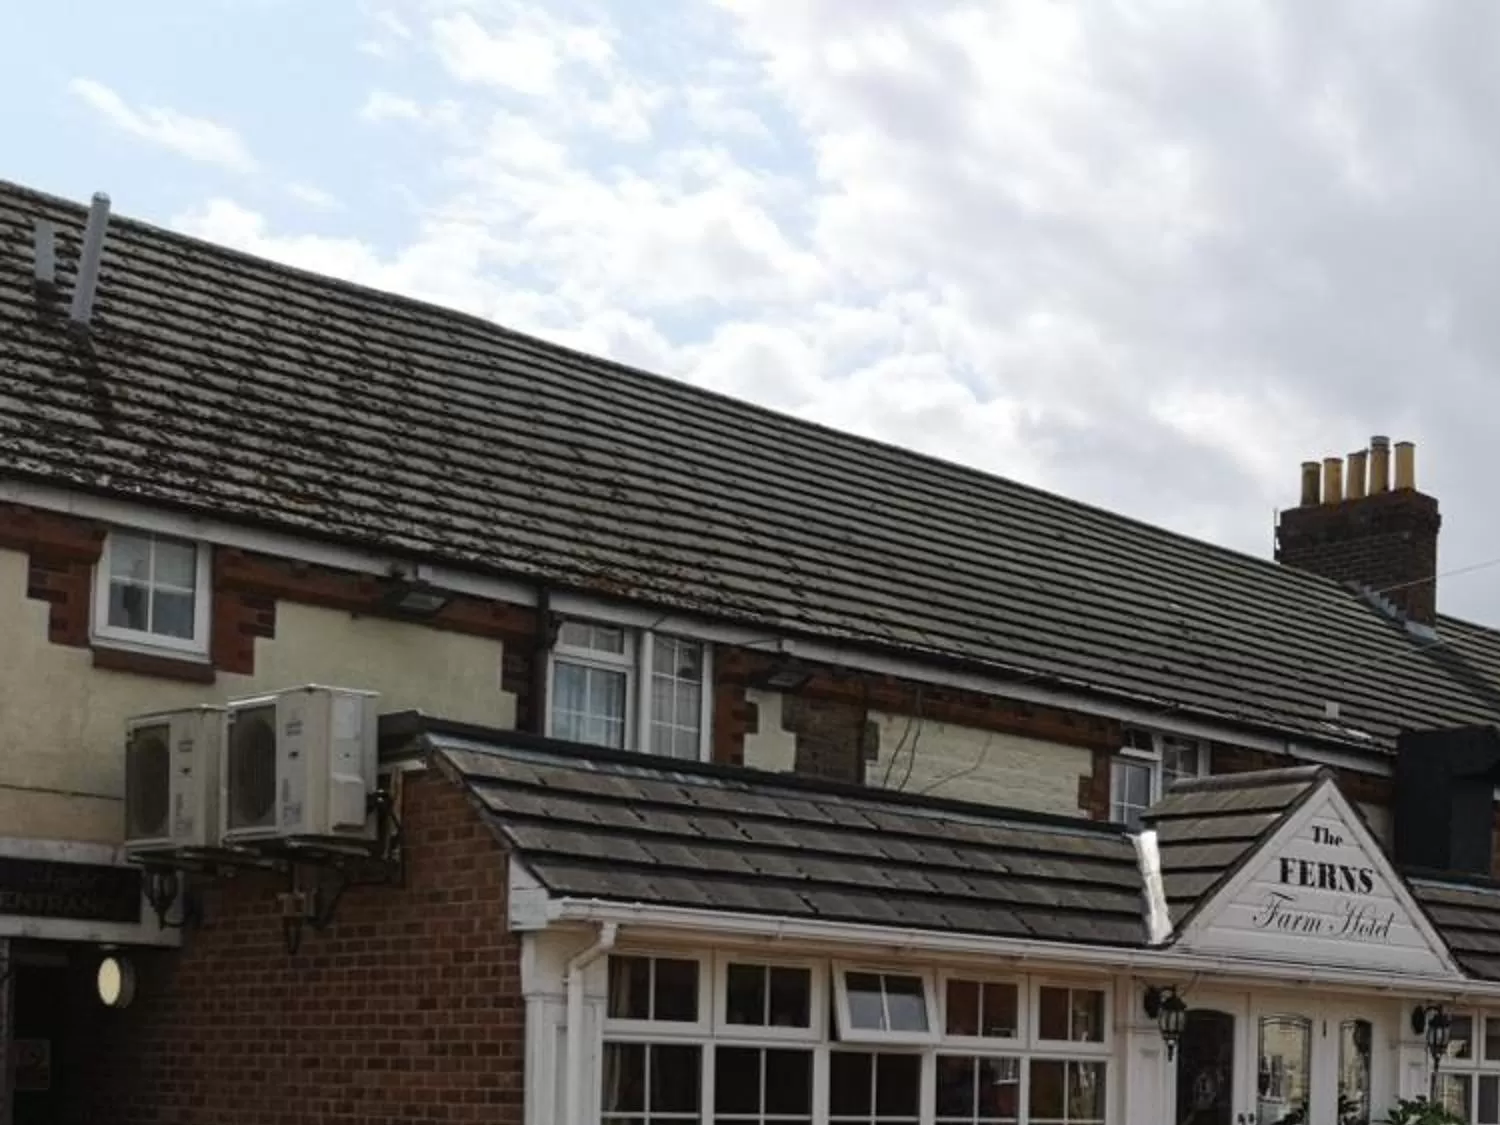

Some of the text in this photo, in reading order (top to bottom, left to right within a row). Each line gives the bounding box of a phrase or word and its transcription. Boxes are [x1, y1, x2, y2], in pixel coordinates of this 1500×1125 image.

[1312, 826, 1343, 847] The
[1279, 857, 1374, 894] FERNS
[1253, 892, 1394, 938] Farm Hotel
